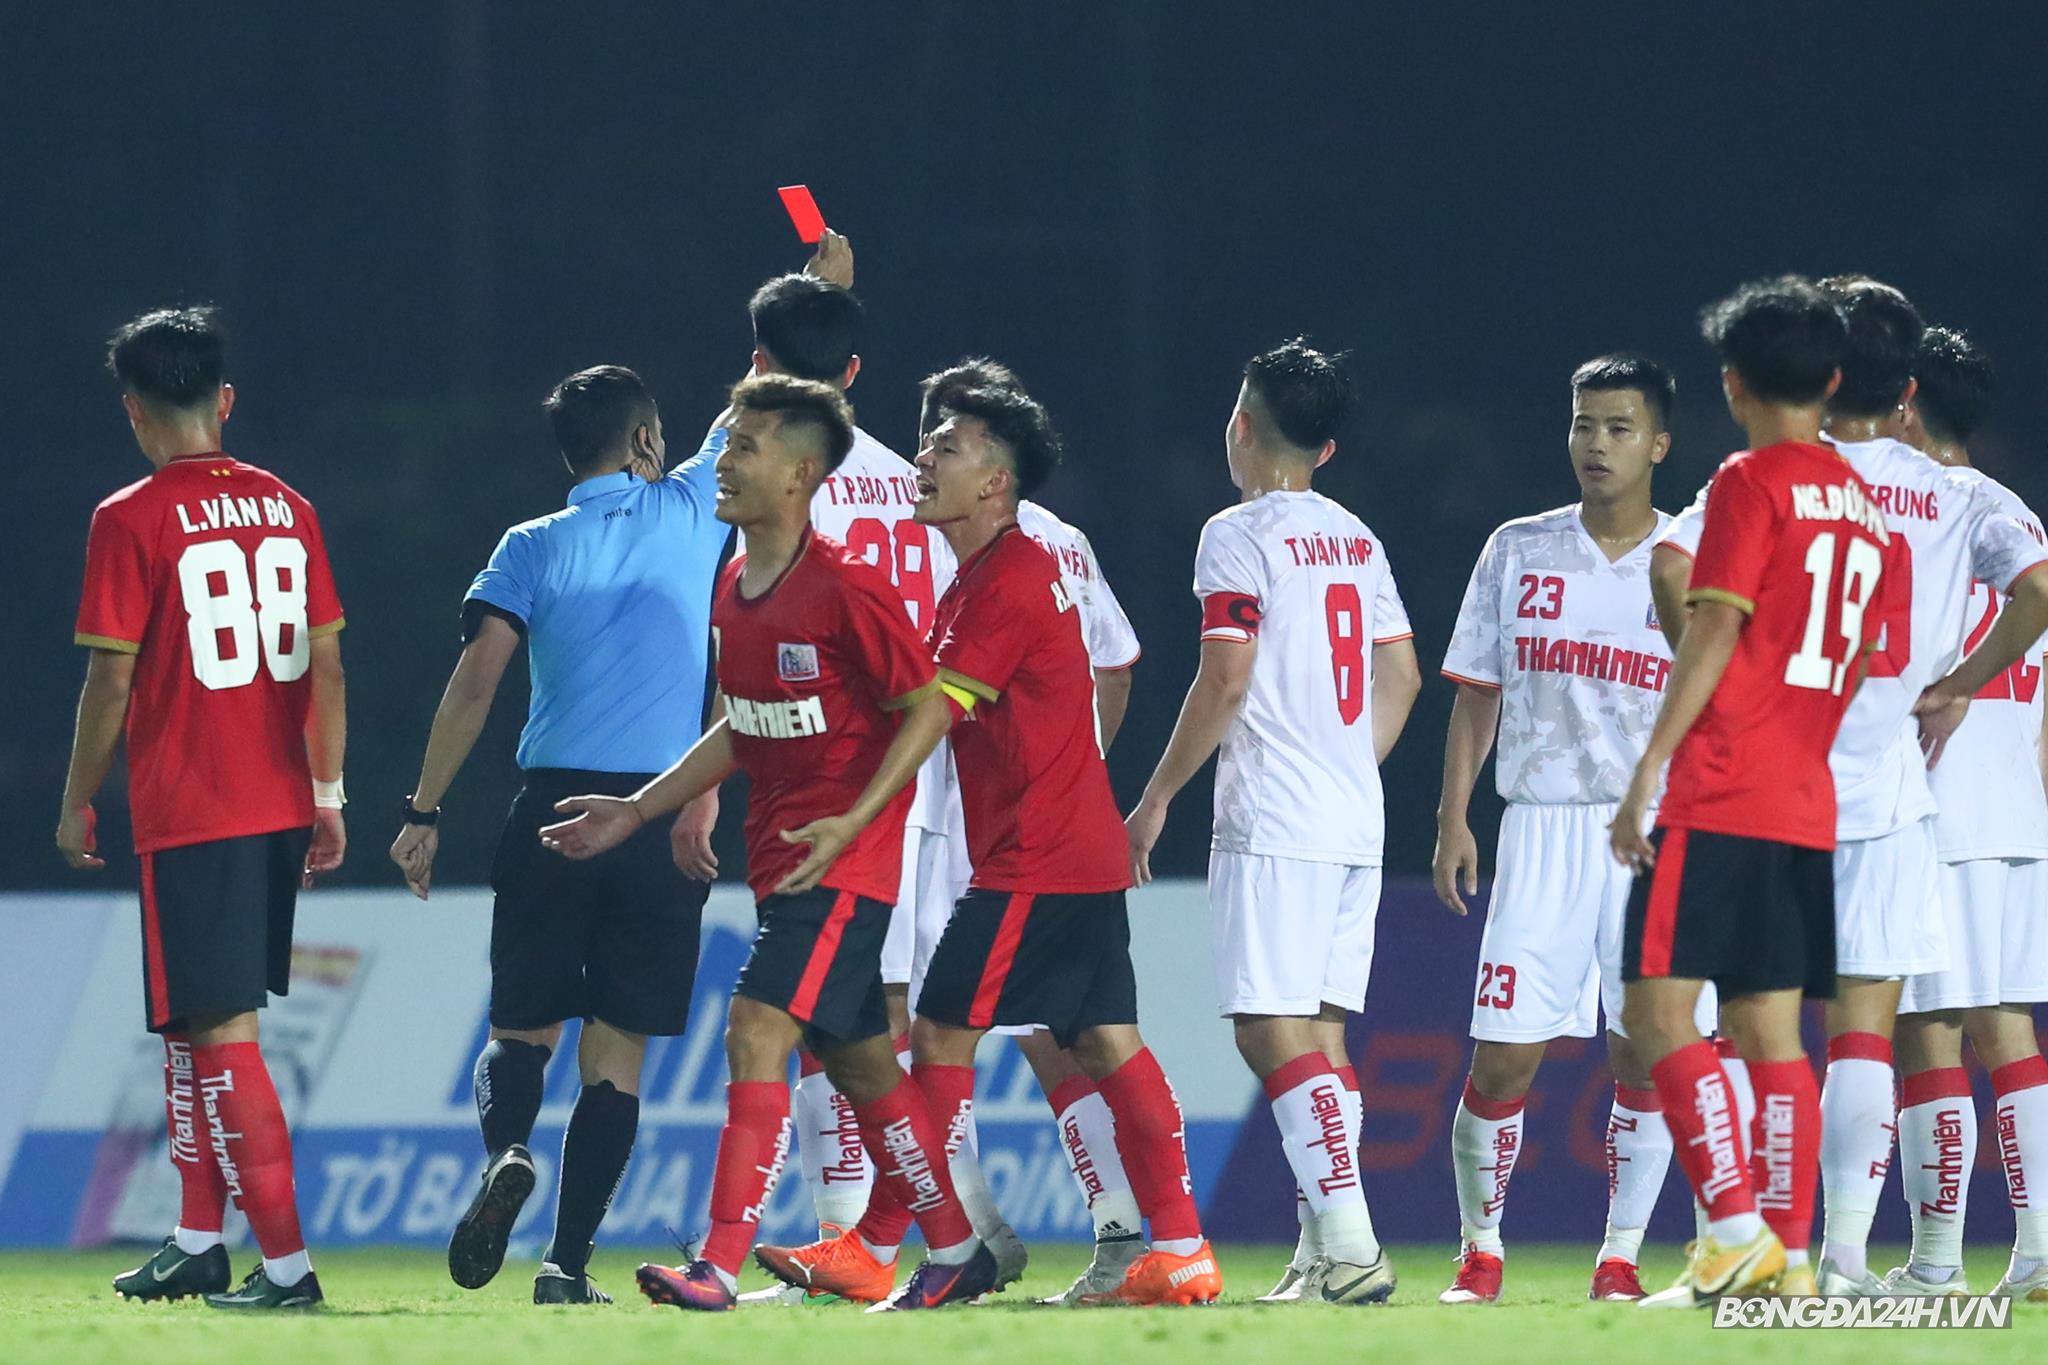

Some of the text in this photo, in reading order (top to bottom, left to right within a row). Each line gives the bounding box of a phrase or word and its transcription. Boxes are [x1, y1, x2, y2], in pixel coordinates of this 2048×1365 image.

[176, 493, 262, 534] L.VĂN
[1285, 531, 1341, 566] T.VĂN
[177, 536, 311, 690] 88
[1228, 599, 1261, 628] C
[1517, 574, 1565, 620] 23
[1784, 532, 1883, 697] 19
[1325, 583, 1364, 726] 8
[1477, 962, 1516, 1009] 23
[1306, 1084, 1356, 1197] Thanhniên
